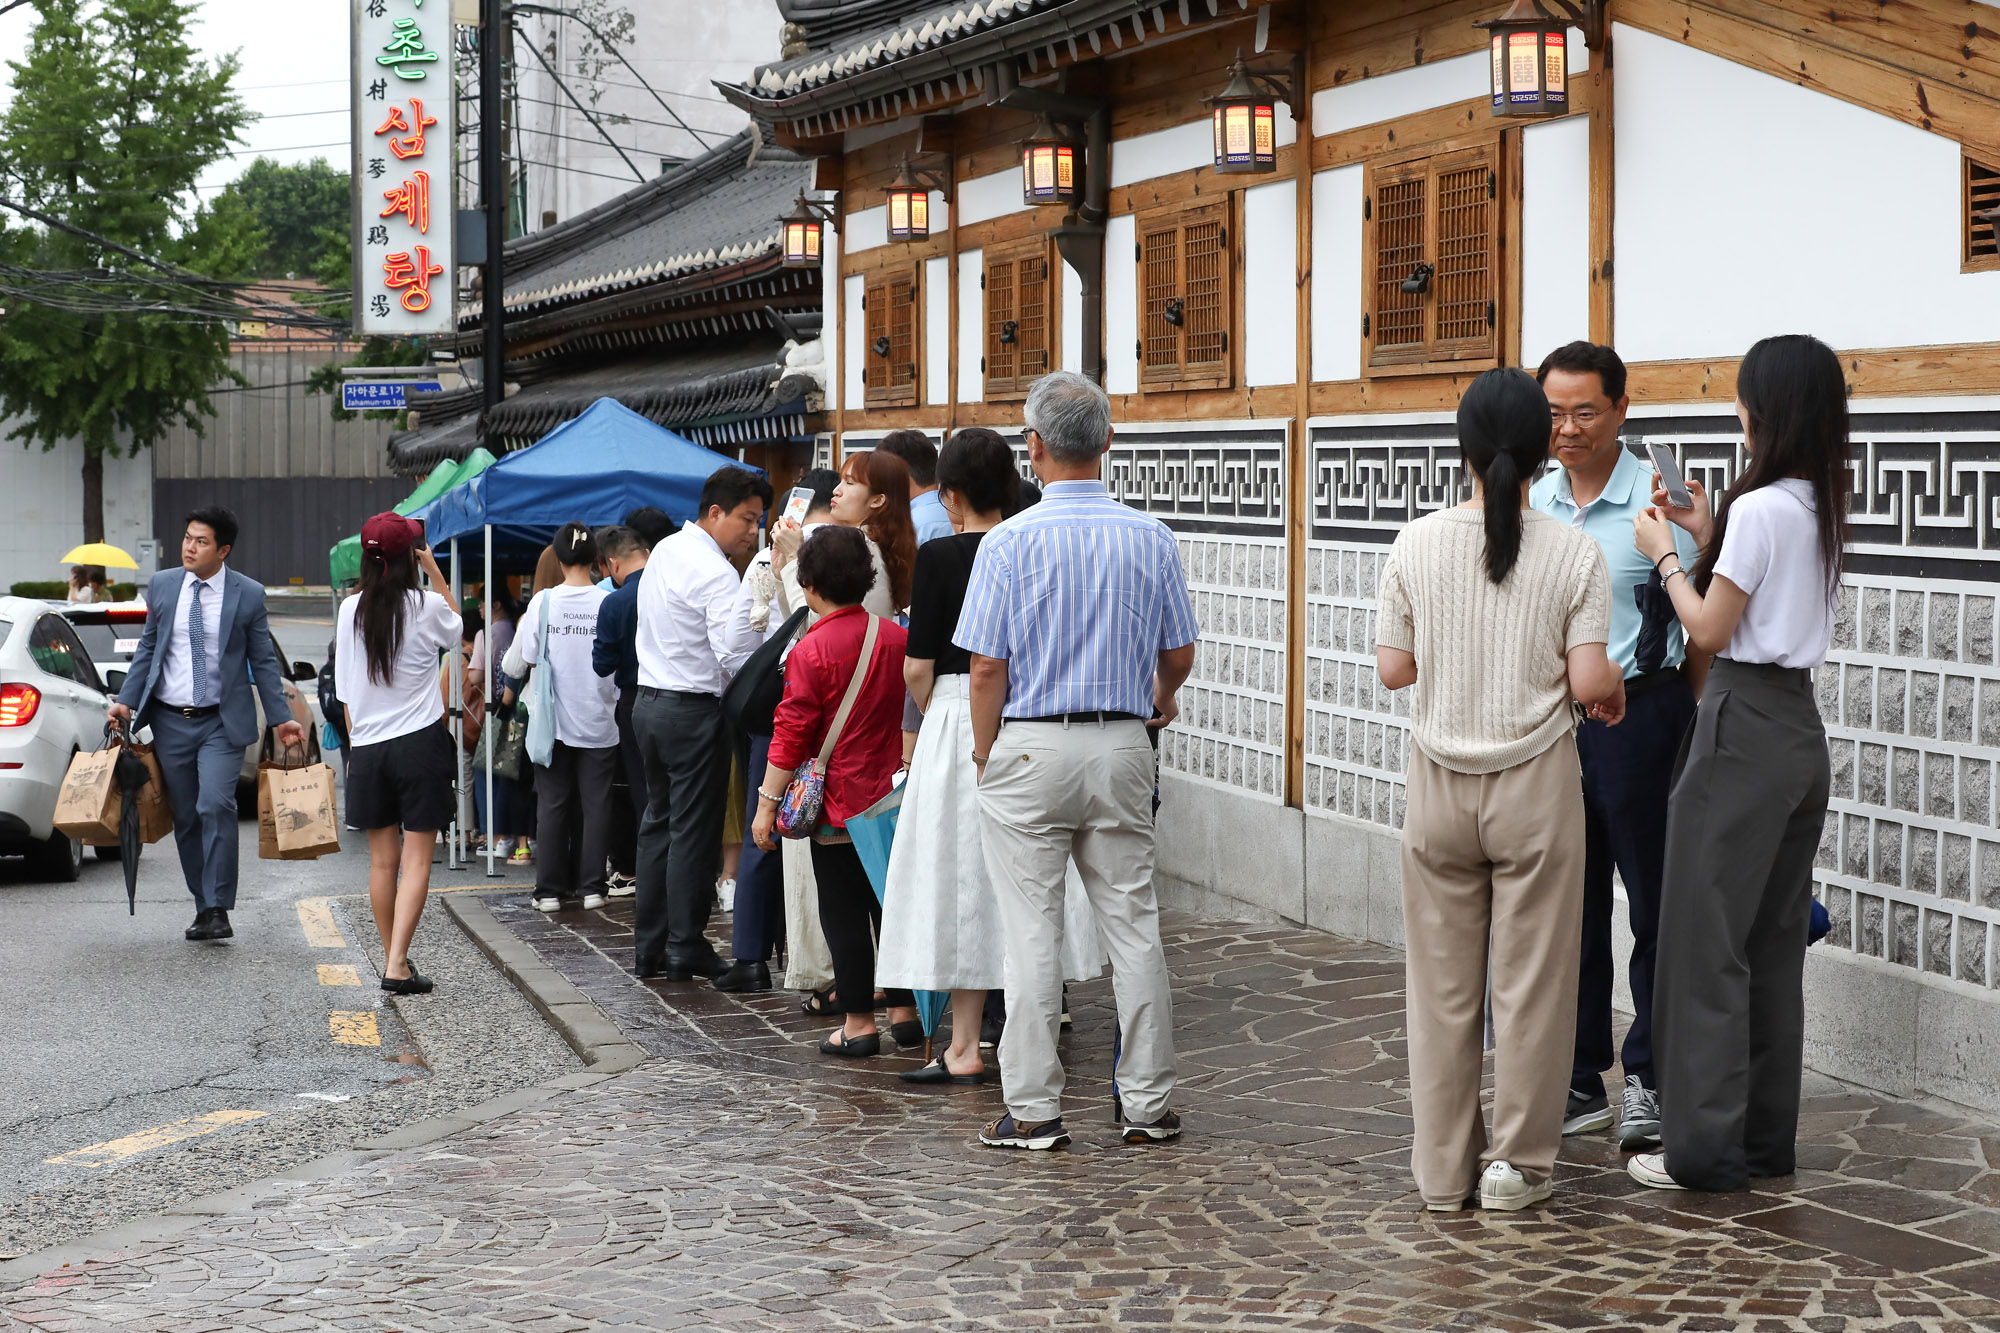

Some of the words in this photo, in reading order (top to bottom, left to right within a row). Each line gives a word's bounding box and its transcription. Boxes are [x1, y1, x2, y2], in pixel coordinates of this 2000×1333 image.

[376, 0, 438, 80] 촌
[347, 398, 390, 406] Jahamun-ro
[562, 625, 588, 636] Fifth
